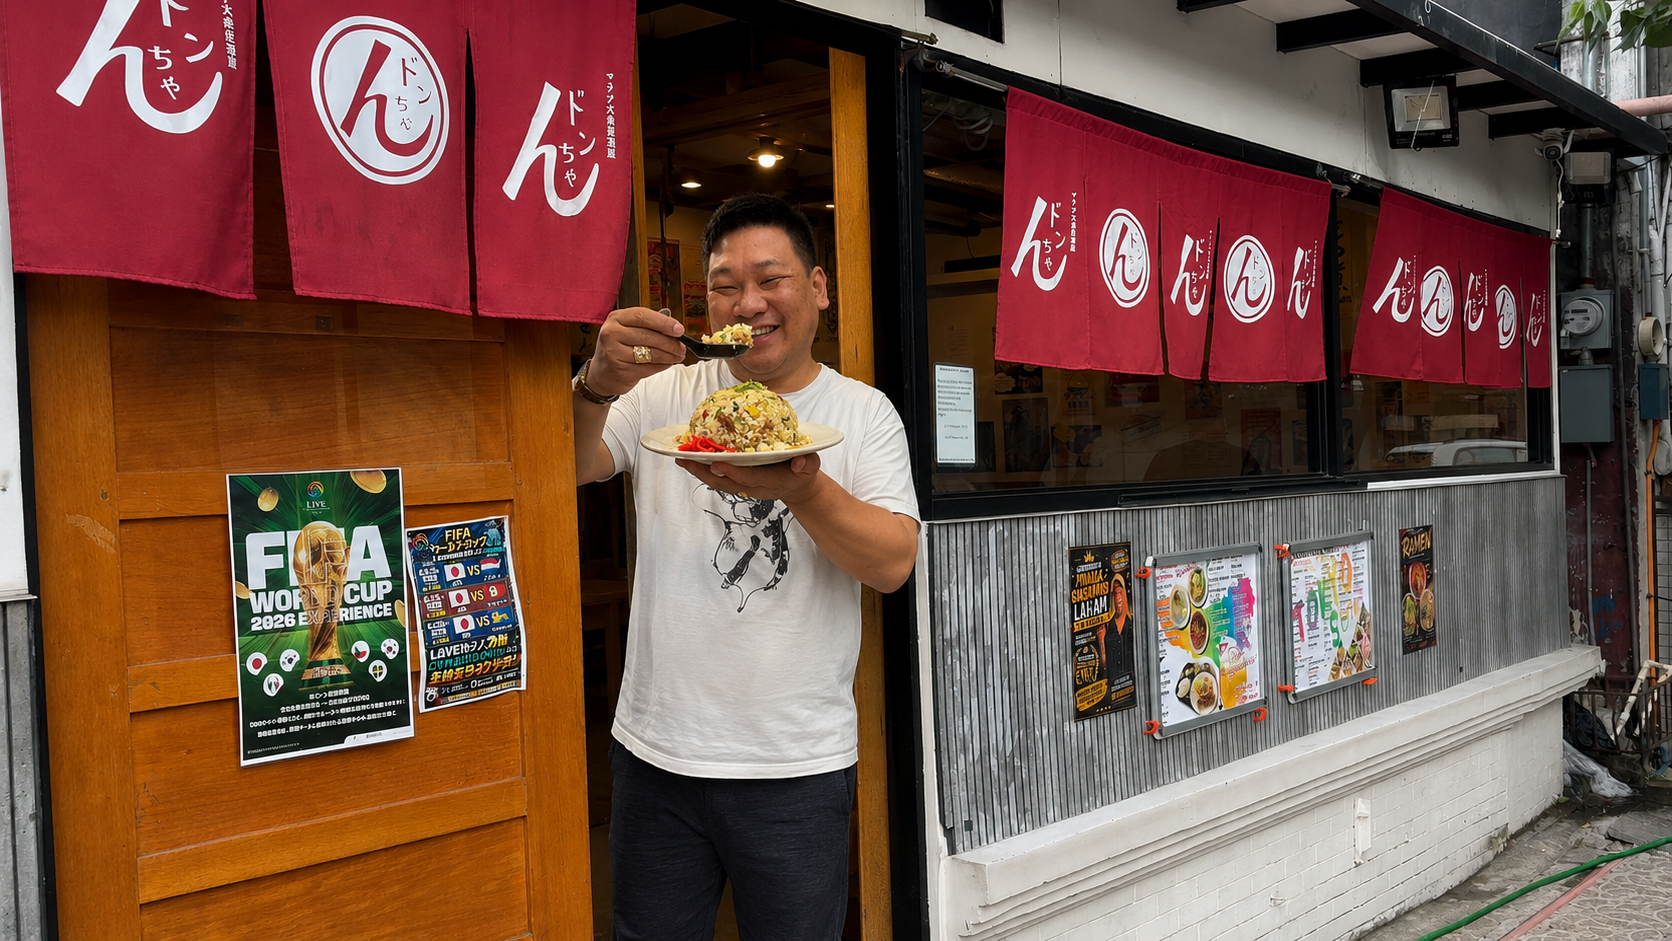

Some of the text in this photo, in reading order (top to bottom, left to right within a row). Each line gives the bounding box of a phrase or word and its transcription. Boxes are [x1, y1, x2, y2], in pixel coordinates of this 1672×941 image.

[340, 38, 434, 157] ん
[568, 90, 596, 156] ドン
[502, 82, 599, 217] ん
[1050, 202, 1066, 249] ドン
[1010, 195, 1068, 292] ん
[1169, 234, 1206, 317] ん
[1372, 256, 1415, 323] ん
[306, 500, 327, 509] LIVE
[445, 527, 471, 542] FIFA
[1401, 527, 1432, 560] RAMEN
[467, 564, 480, 576] VS
[343, 580, 393, 605] CUP
[470, 589, 484, 602] VS
[250, 612, 296, 631] 2026
[475, 615, 490, 627] VS
[1074, 595, 1108, 621] LAHAM
